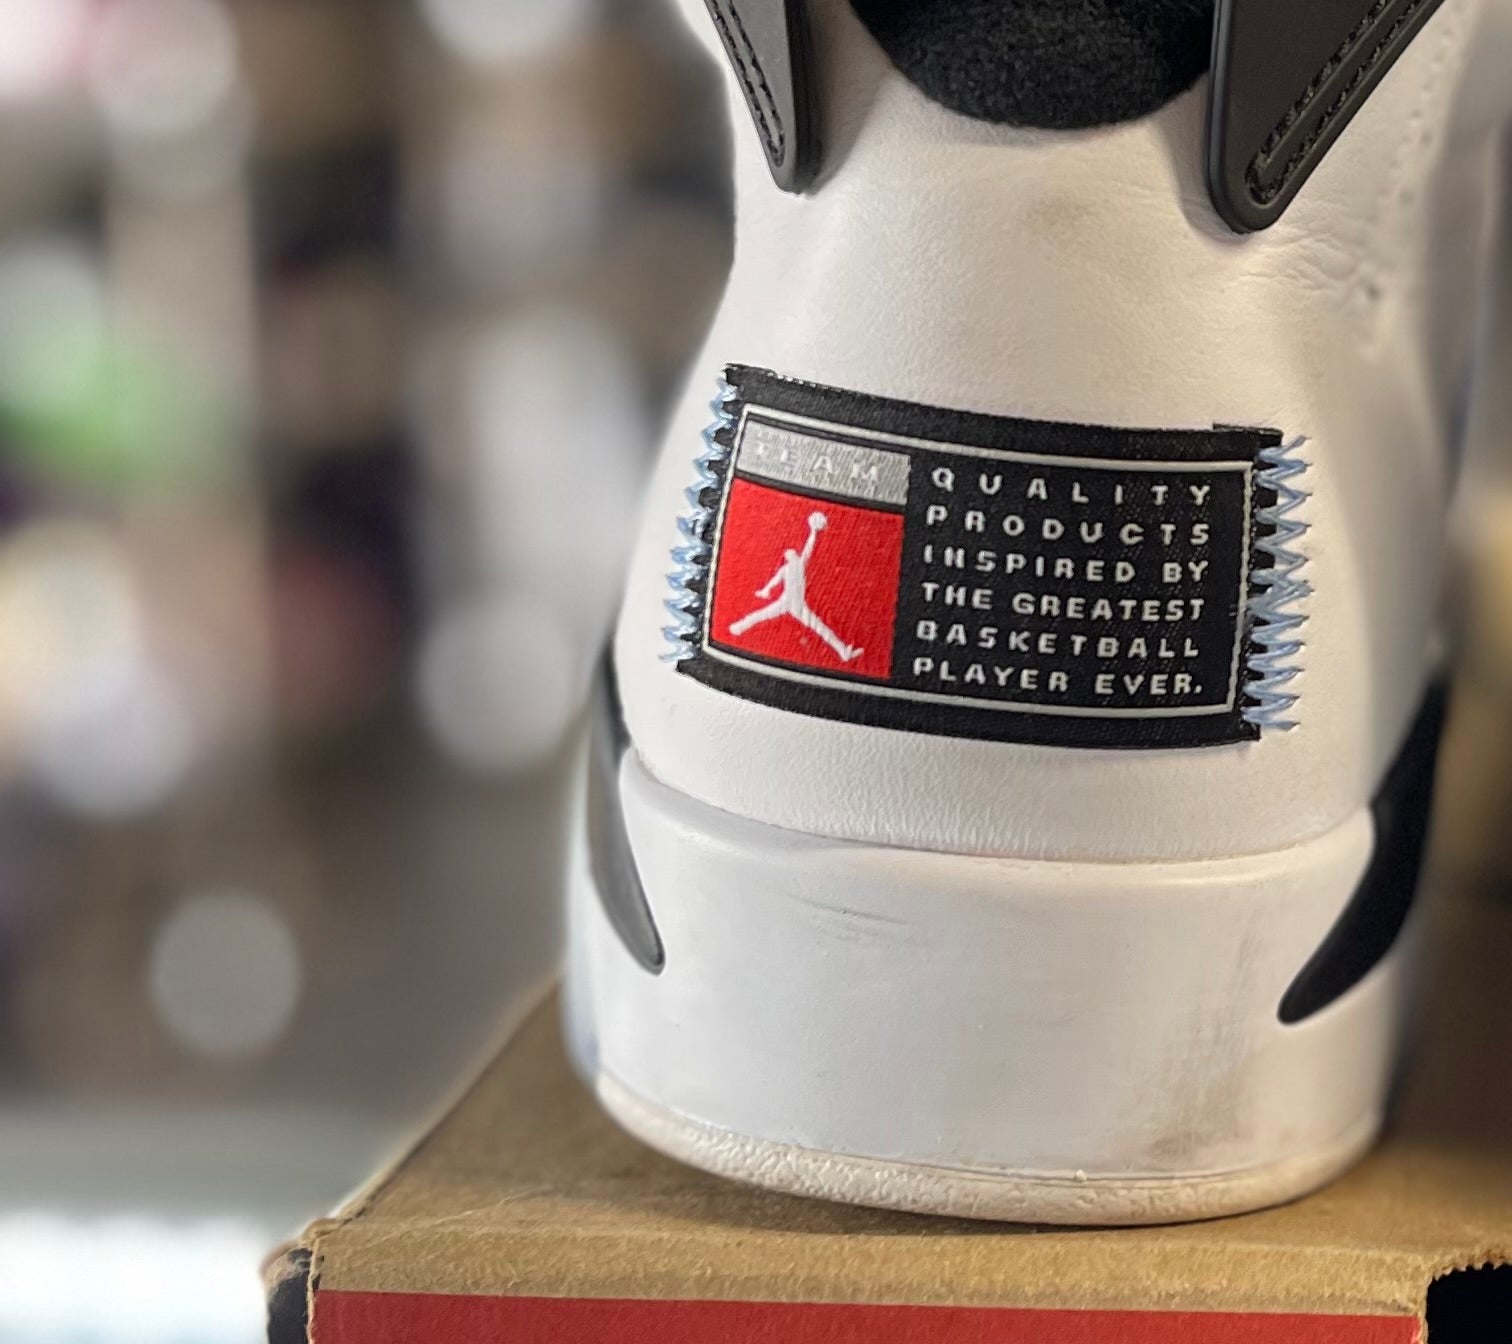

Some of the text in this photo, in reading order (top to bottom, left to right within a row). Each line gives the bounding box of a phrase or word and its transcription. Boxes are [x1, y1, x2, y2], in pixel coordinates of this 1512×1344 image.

[754, 439, 880, 481] TEAM
[931, 467, 1211, 506] QUALITY
[926, 505, 1210, 546] PRODUCTS
[924, 545, 1209, 585] INSPIRED BY
[920, 582, 1205, 622] THE GREATEST
[916, 620, 1201, 659] BASKETBALL
[913, 657, 1205, 696] PLAYER EVER.
